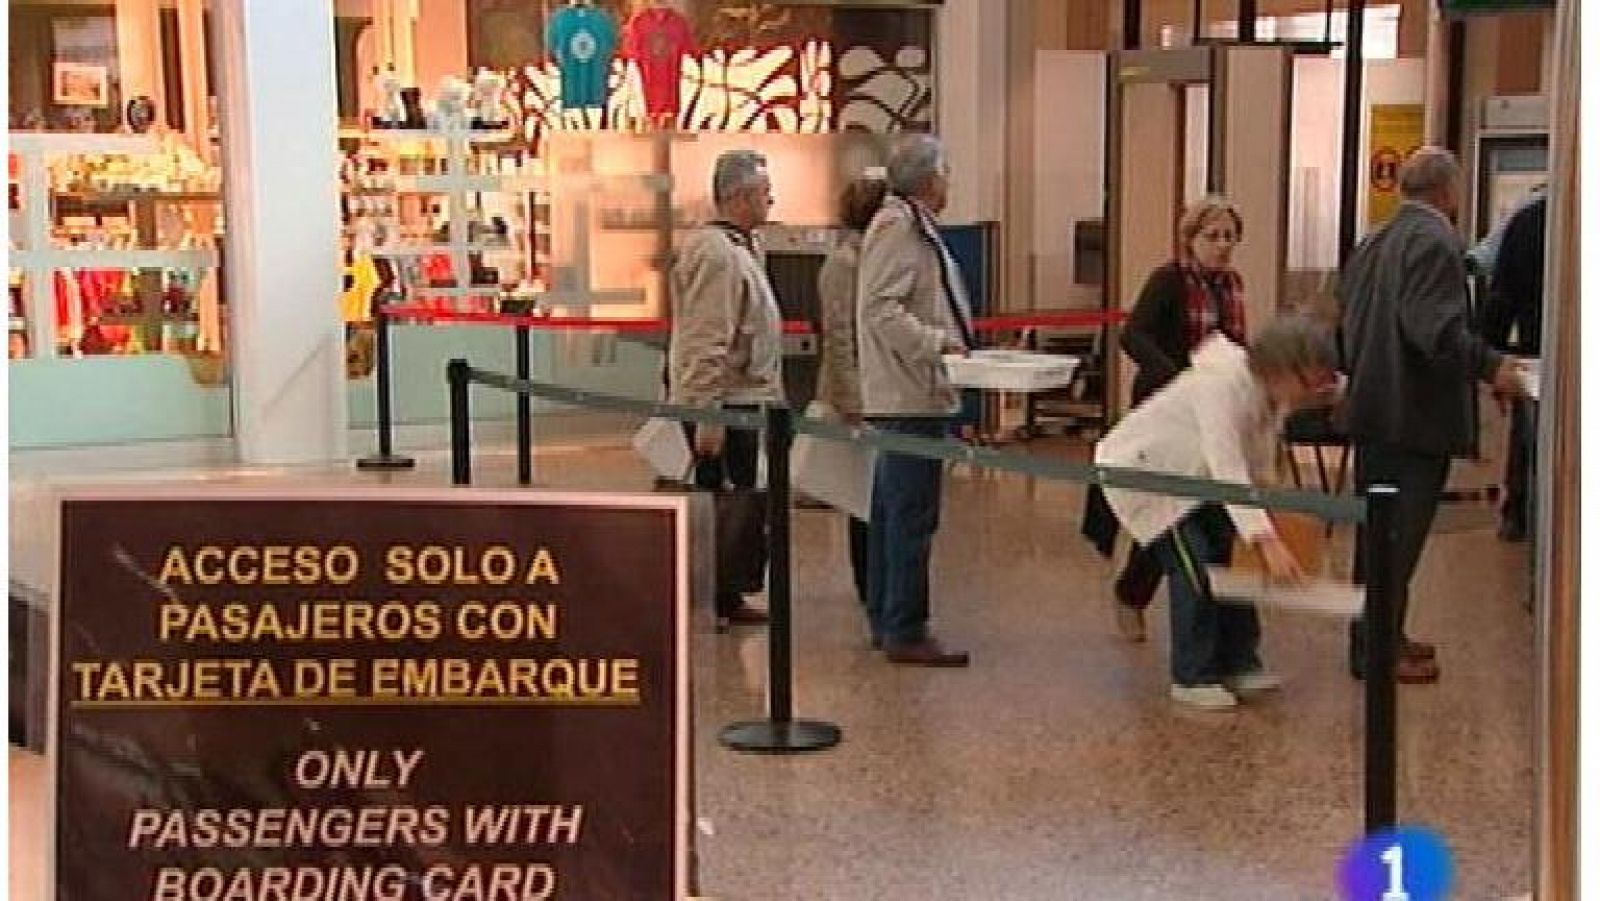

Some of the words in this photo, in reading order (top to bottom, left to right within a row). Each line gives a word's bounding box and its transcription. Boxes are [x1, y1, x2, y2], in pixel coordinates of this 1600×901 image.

[160, 546, 359, 585] ACCESO
[386, 546, 515, 585] SOLO
[526, 549, 560, 585] A
[159, 602, 442, 641] PASAJEROS
[457, 602, 557, 641] CON
[73, 660, 281, 698] TARJETA
[295, 660, 356, 698] DE
[373, 658, 640, 698] EMBARQUE
[295, 750, 423, 789] ONLY
[129, 806, 449, 848] PASSENGERS
[465, 804, 582, 844] WITH
[154, 866, 407, 901] BOARDING
[421, 863, 556, 901] CARD
